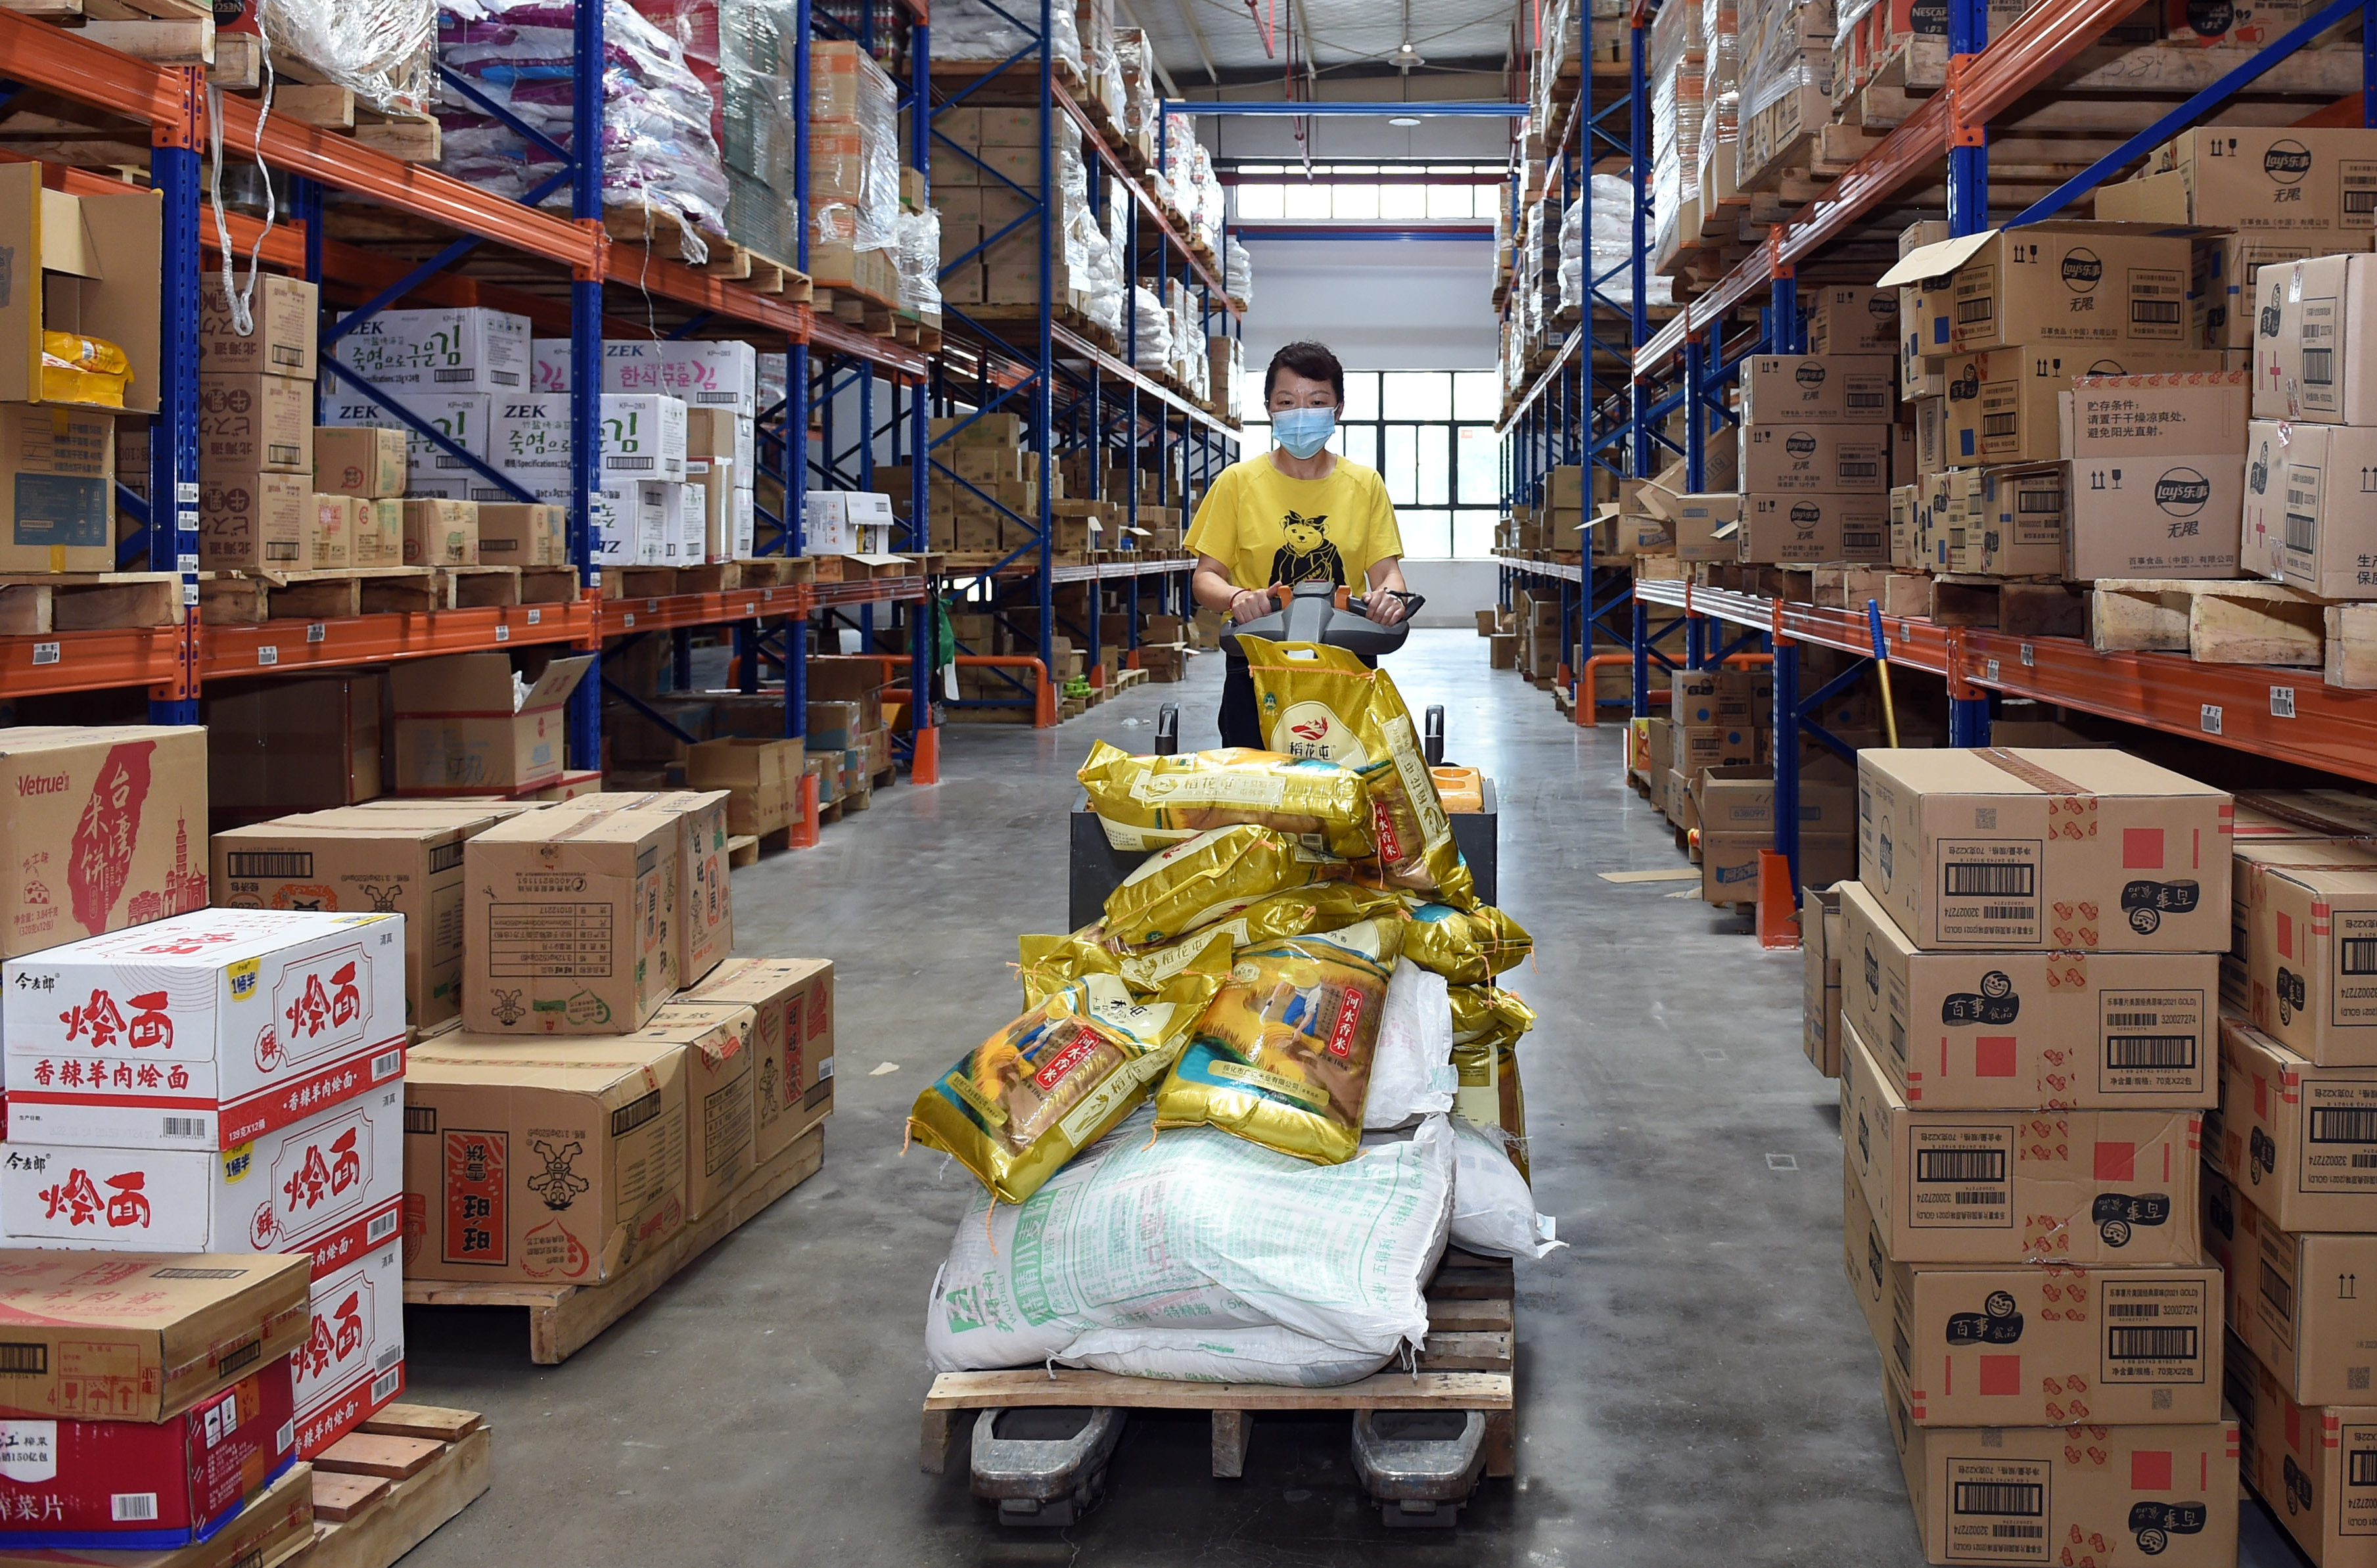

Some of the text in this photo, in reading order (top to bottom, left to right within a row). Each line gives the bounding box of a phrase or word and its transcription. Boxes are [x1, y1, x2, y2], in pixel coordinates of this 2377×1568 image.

[2273, 187, 2301, 203] 无限
[2070, 297, 2094, 313] 无限
[607, 344, 645, 357] ZEK
[339, 405, 380, 420] ZEK
[503, 404, 548, 420] ZEK
[2087, 400, 2140, 412] 贮存条件：
[2087, 411, 2186, 426] 请置于干燥凉爽处，
[2087, 426, 2163, 439] 避免阳光直射。
[210, 442, 253, 455] 北海道
[2167, 520, 2200, 539] 无限
[208, 542, 251, 555] 北海道
[2129, 555, 2234, 566] 百事食品（中国）有限公司
[18, 774, 64, 797] Vetrue
[1944, 908, 1979, 917] 320027274
[15, 971, 55, 994] 今麦郎
[285, 960, 361, 1040] 烩面
[1947, 996, 2013, 1021] 百事食品
[58, 988, 173, 1049] 烩面
[1330, 993, 1360, 1051] 河水香米
[2161, 1014, 2196, 1025] 320027274
[1042, 1034, 1096, 1083] 河水香米
[34, 1059, 190, 1091] 香辣羊肉烩面
[289, 1075, 353, 1111] 香辣羊肉烩面
[4, 1151, 46, 1175] 今麦郎
[2309, 1155, 2347, 1166] 320027274
[283, 1126, 360, 1213] 烩面
[38, 1168, 151, 1230] 烩面
[1916, 1193, 1952, 1203] 320027274
[2162, 1305, 2198, 1315] 320027274
[1952, 1316, 2017, 1339] 百事食品
[1954, 1525, 1989, 1536] 320027274
